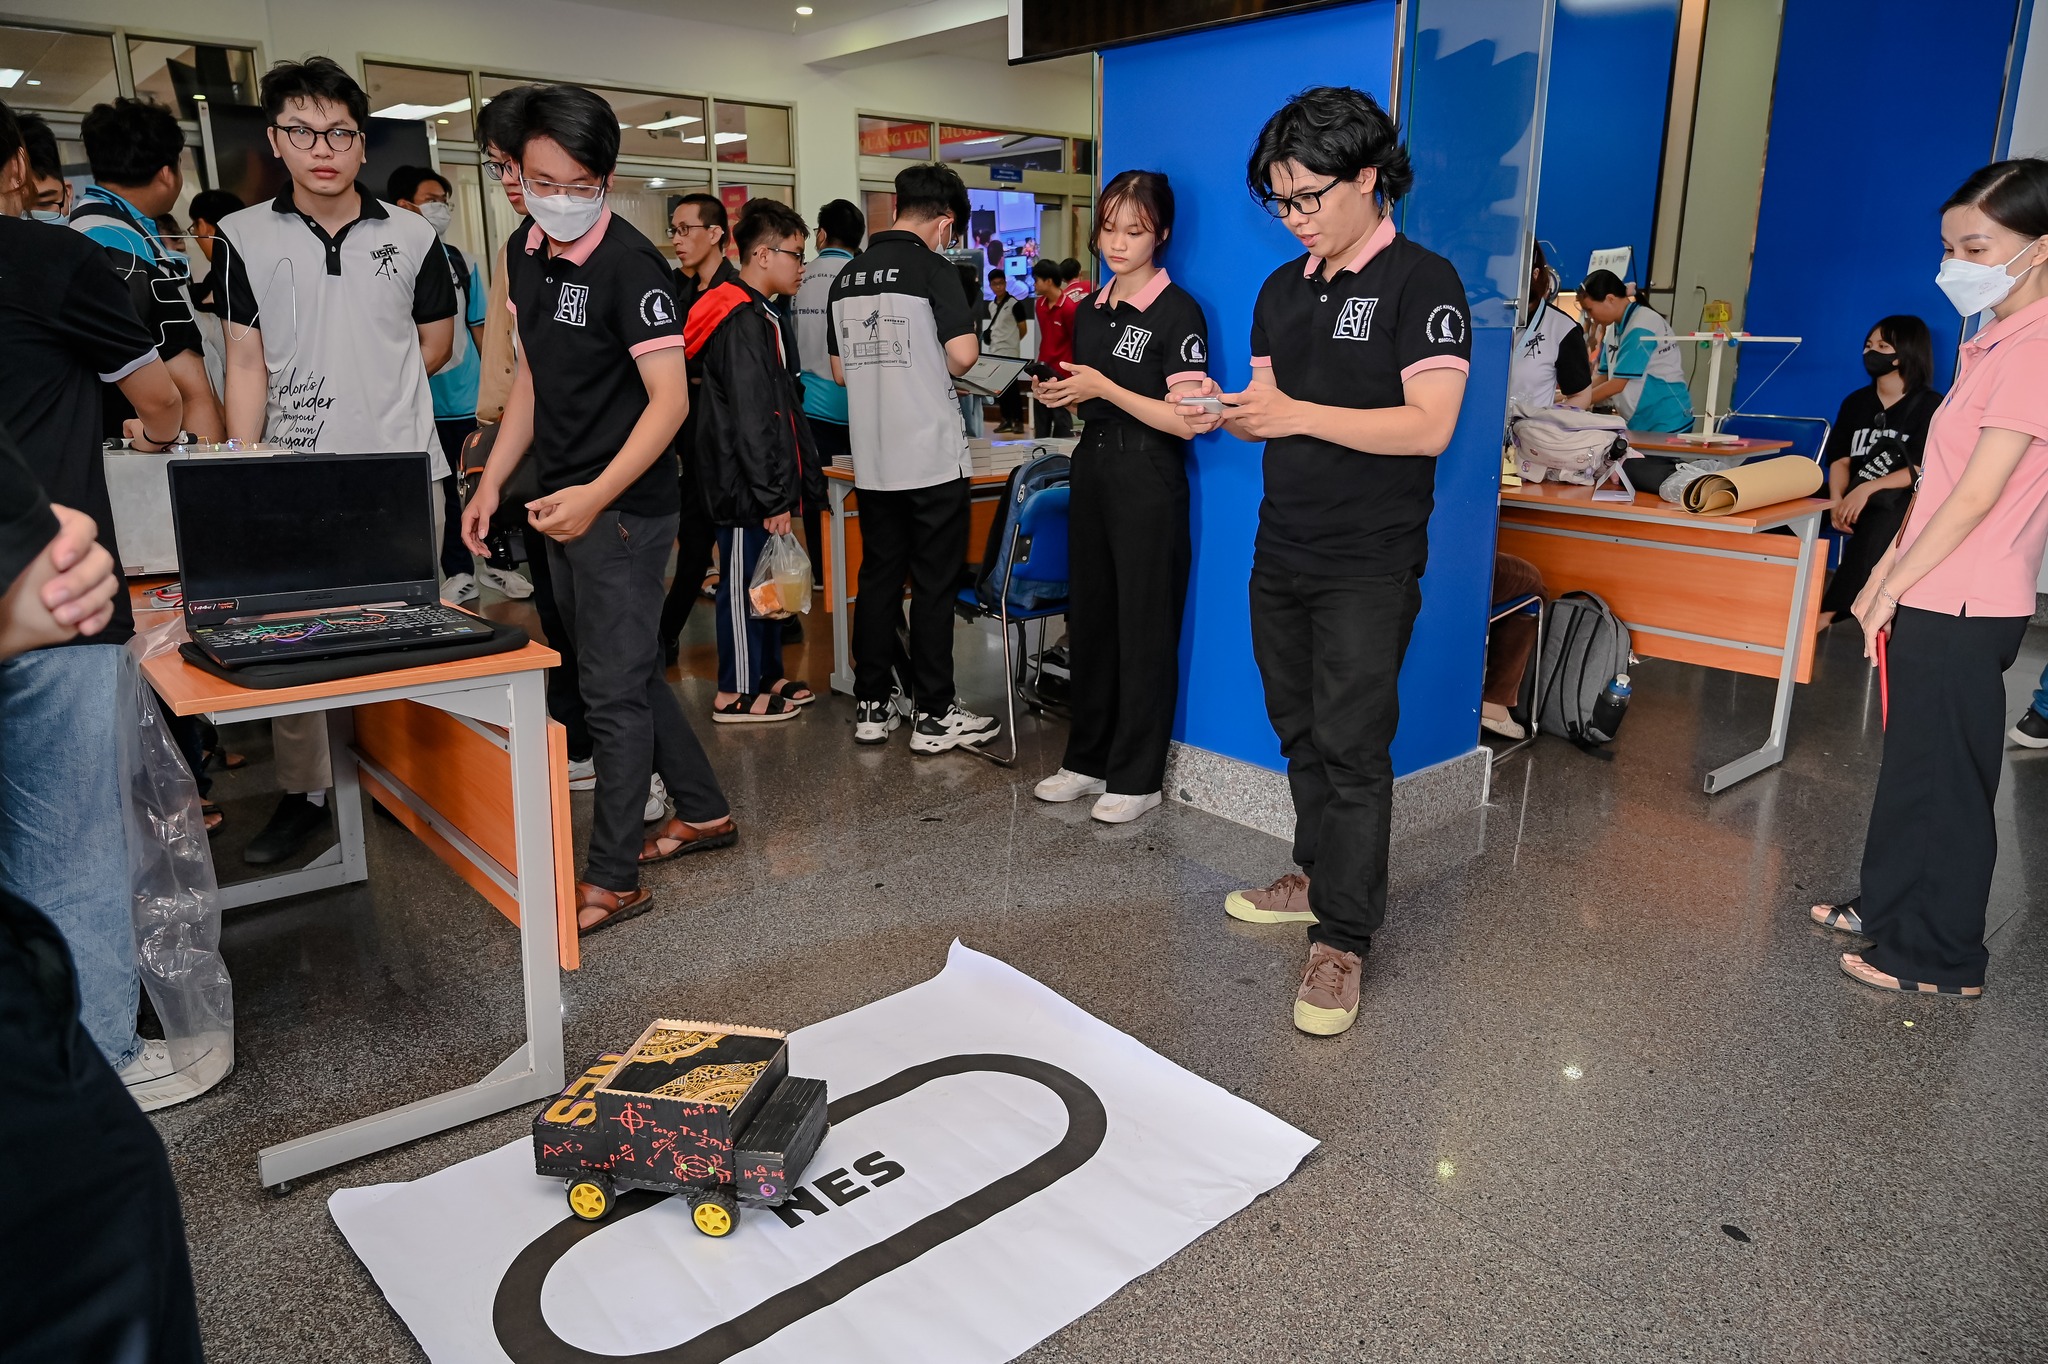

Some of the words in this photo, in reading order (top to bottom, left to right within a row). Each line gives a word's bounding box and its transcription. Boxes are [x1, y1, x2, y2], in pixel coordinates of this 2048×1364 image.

[370, 246, 399, 260] USAC
[841, 268, 899, 288] USAC
[295, 426, 317, 435] own
[766, 1150, 906, 1229] NES
